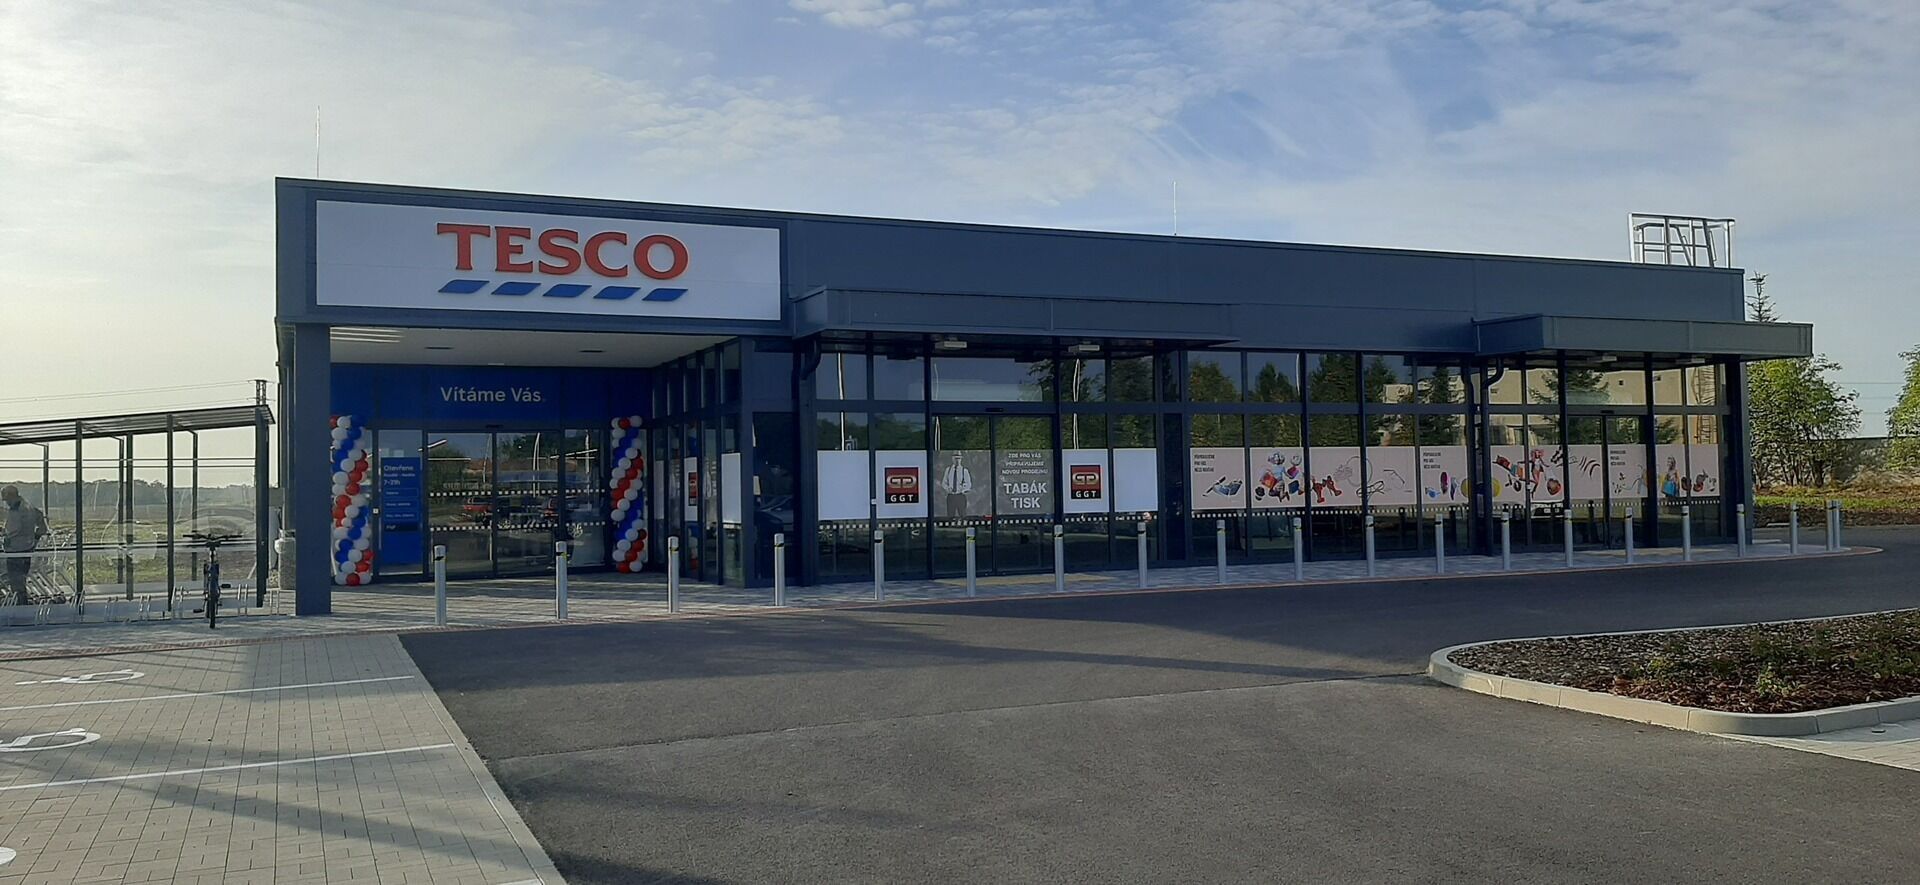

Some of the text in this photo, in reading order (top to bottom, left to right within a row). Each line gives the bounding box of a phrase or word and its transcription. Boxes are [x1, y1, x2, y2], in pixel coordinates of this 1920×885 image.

[437, 223, 689, 280] TESCO
[440, 387, 506, 402] Vítáme
[1003, 480, 1047, 494] TABÁK
[1011, 497, 1041, 509] TISK
